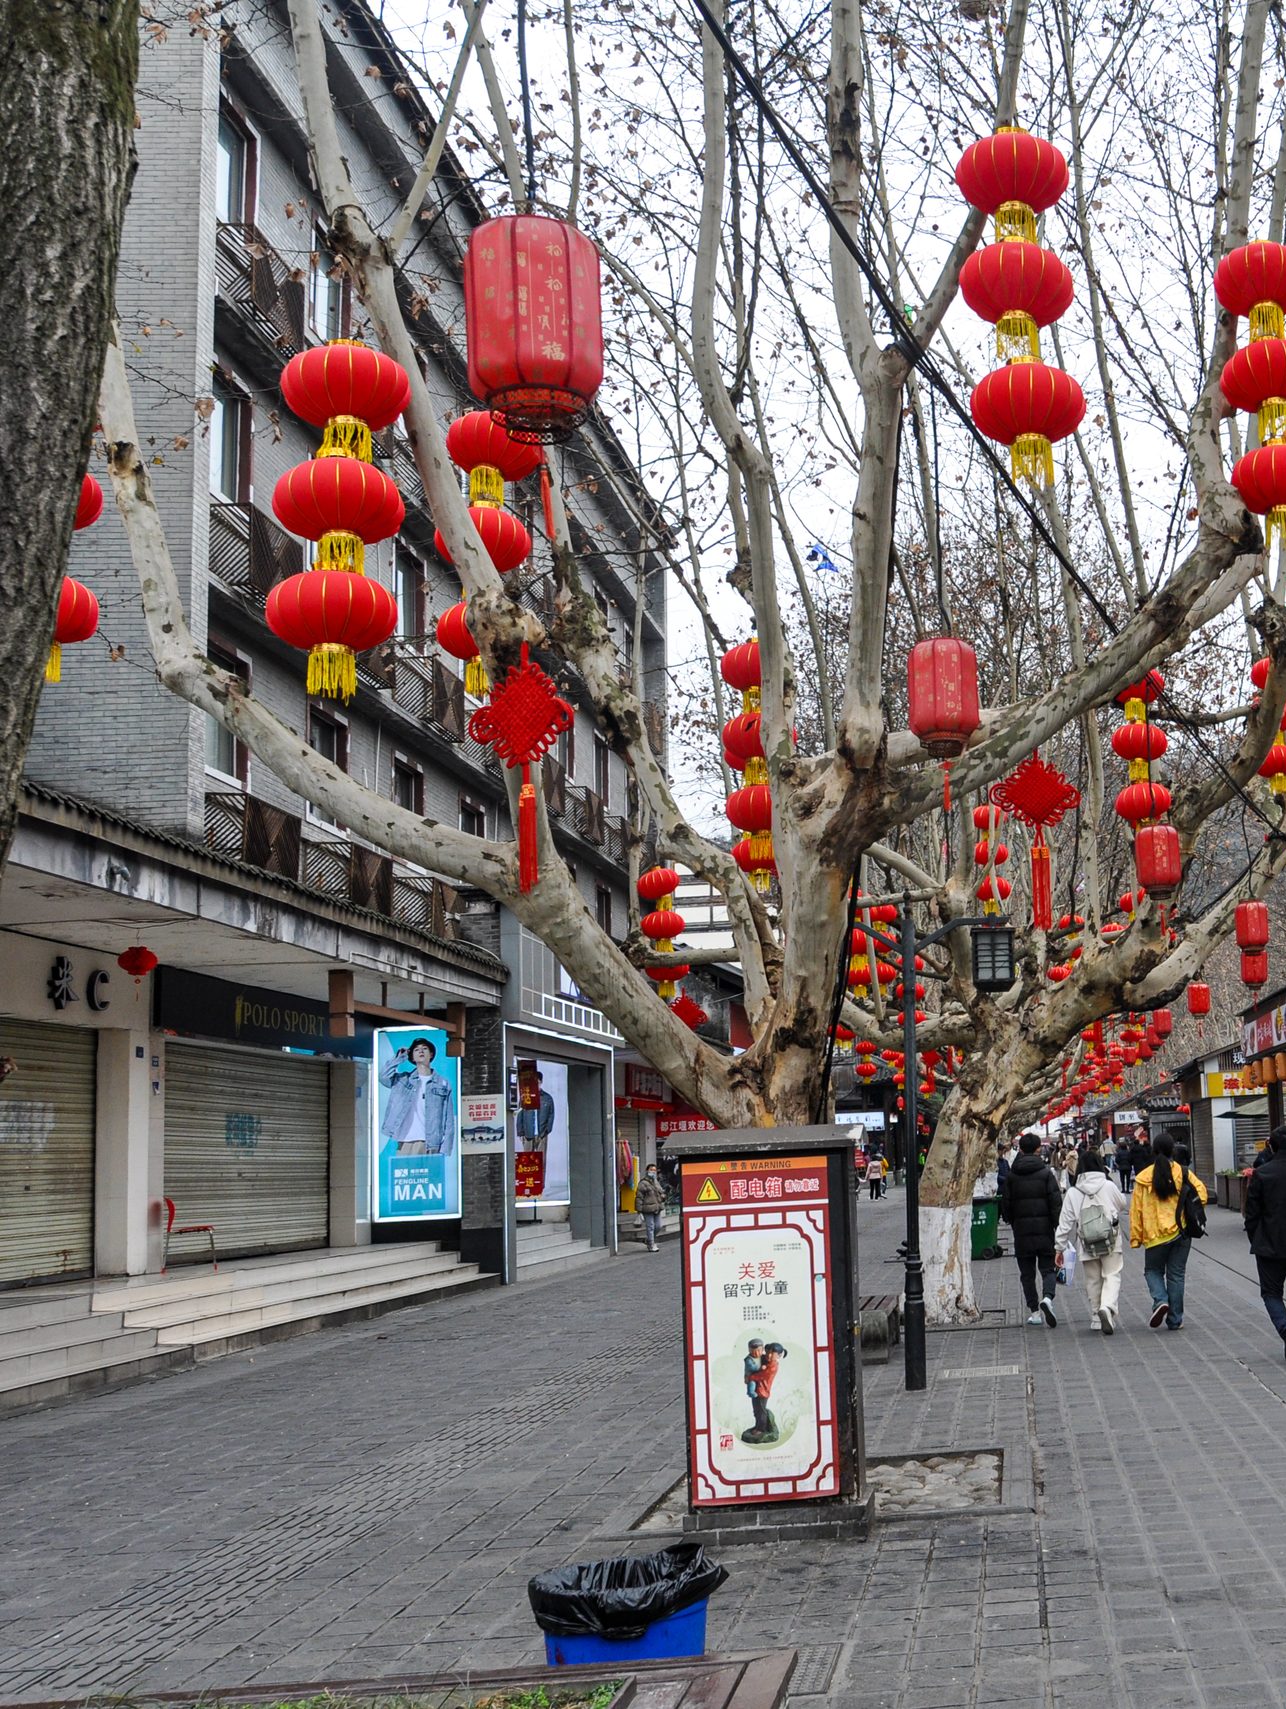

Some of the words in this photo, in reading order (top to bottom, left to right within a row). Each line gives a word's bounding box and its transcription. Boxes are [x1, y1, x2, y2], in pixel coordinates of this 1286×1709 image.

[243, 1001, 281, 1029] POLO
[284, 1006, 326, 1037] SPORT
[730, 1161, 747, 1170] 警告
[750, 1160, 792, 1170] WARNING
[394, 1183, 442, 1201] MAN
[730, 1177, 783, 1199] 配电箱
[784, 1178, 820, 1193] 请勿靠近
[738, 1261, 776, 1280] 关爱
[723, 1280, 789, 1298] 留守儿童
